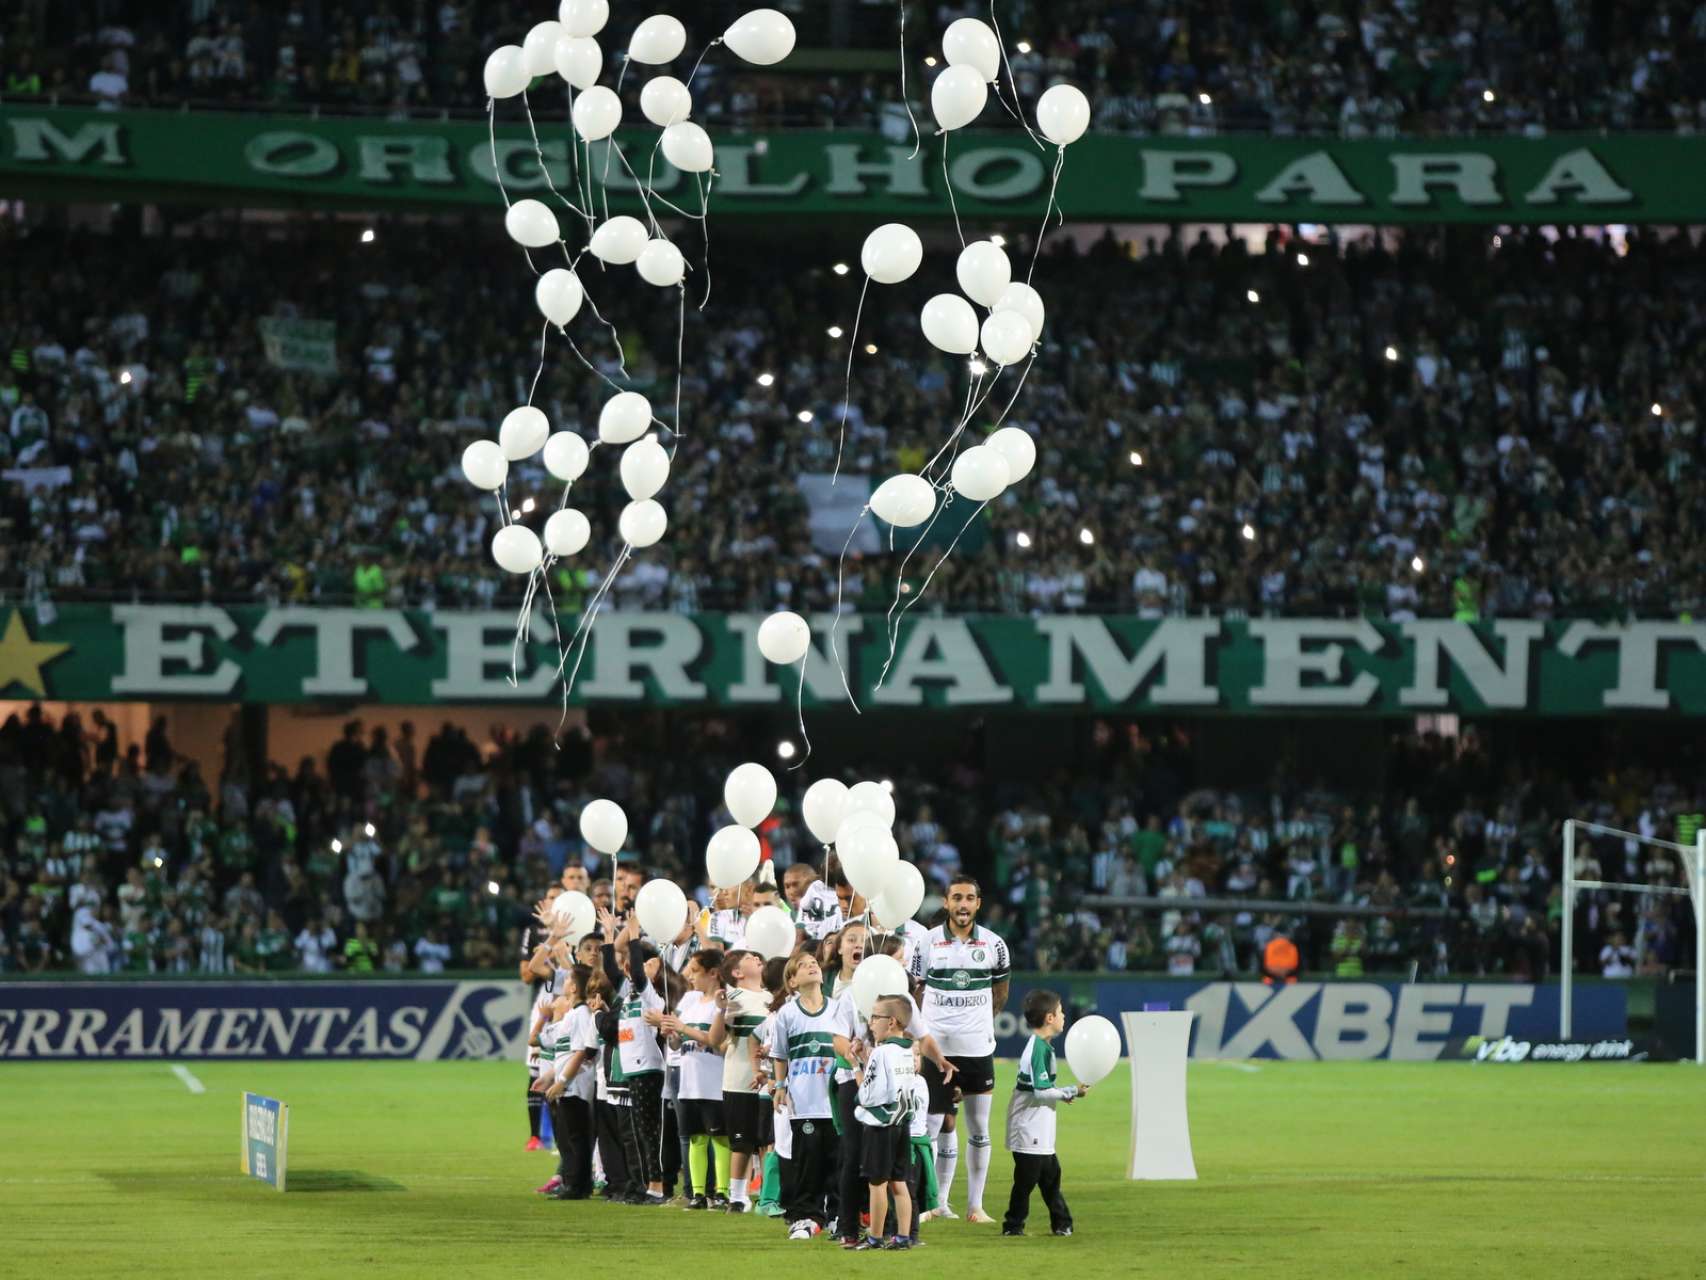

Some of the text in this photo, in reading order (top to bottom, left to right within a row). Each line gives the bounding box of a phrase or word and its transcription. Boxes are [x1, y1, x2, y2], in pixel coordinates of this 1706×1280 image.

[8, 117, 1632, 205] M ORGULHO PARA
[110, 604, 1706, 708] ETERNAMENT
[935, 993, 987, 1007] MADERO
[1185, 982, 1534, 1061] 1XBET
[792, 1056, 833, 1076] CAIX
[1532, 1043, 1591, 1062] energy
[1589, 1038, 1635, 1059] drink
